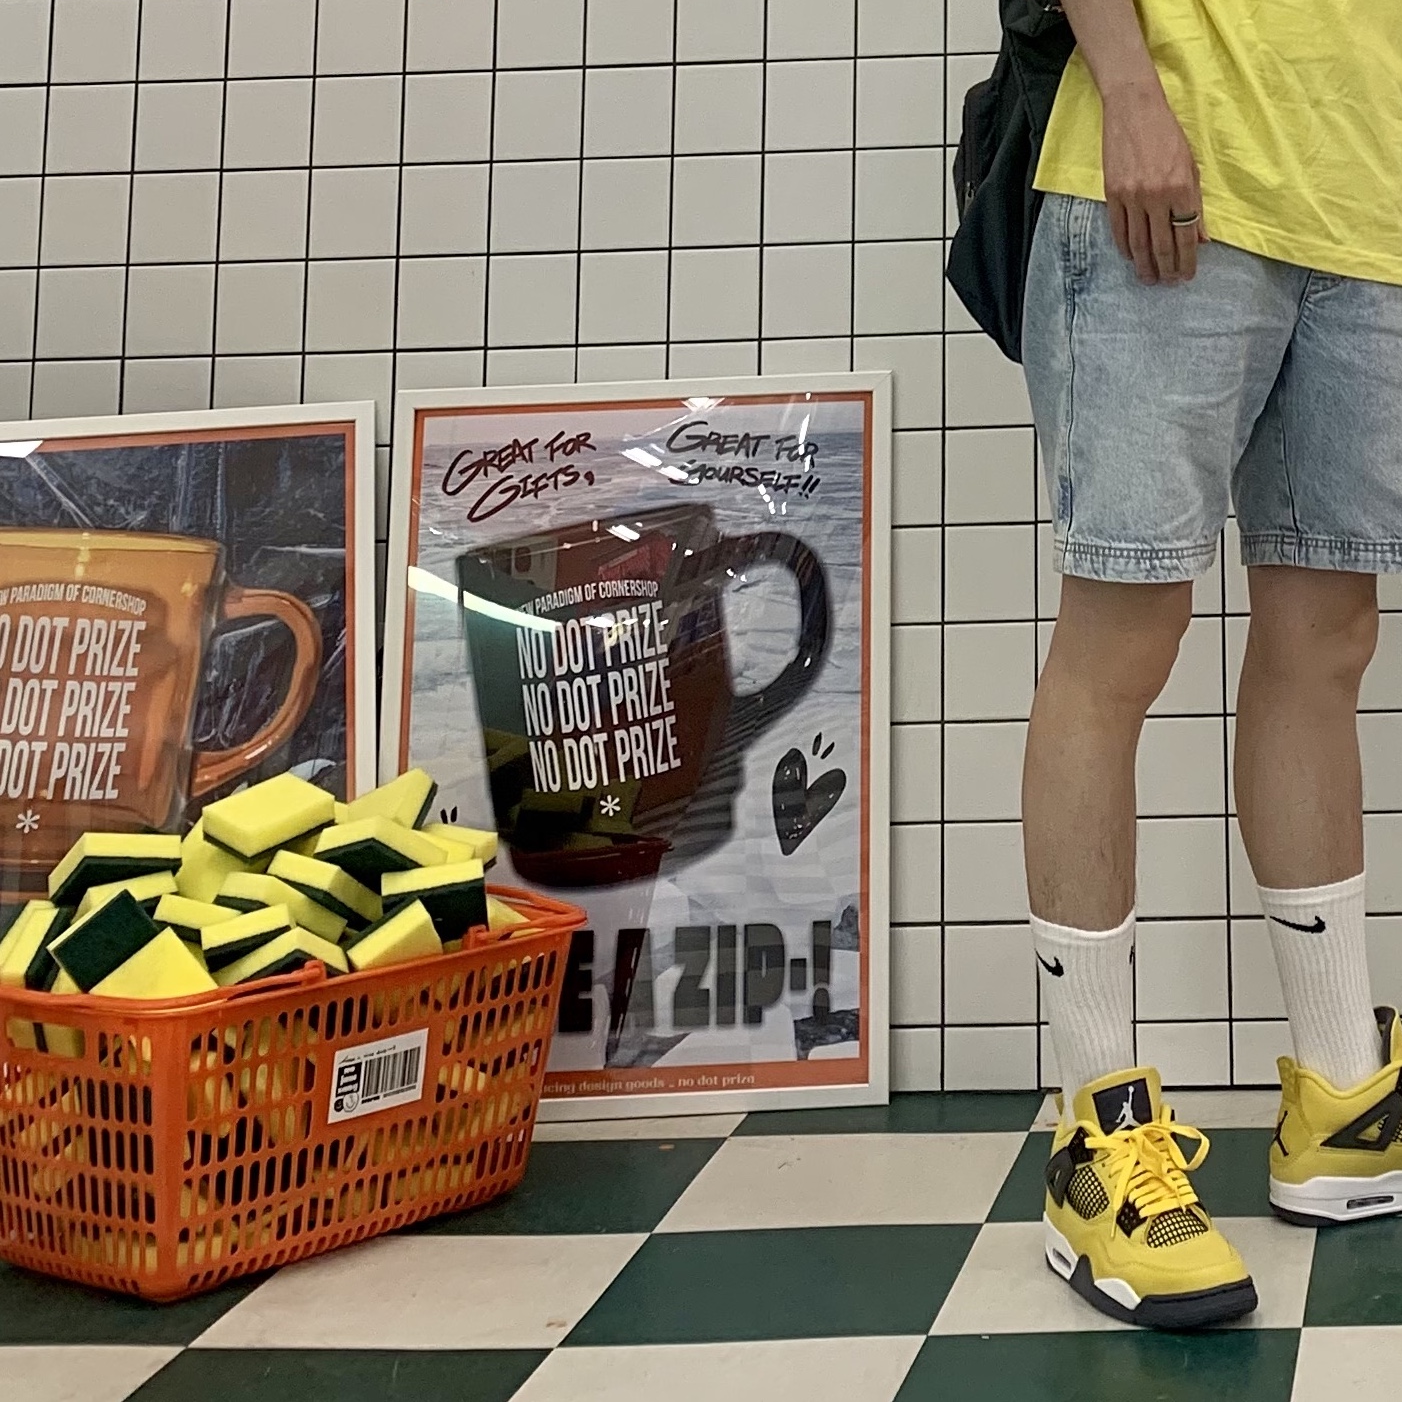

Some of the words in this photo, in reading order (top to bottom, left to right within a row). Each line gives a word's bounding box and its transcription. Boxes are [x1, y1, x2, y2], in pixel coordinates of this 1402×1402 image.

[442, 437, 539, 496] GREAT
[545, 430, 597, 462] FOR
[664, 420, 770, 458] GREAT
[776, 434, 820, 466] FOR
[10, 583, 65, 604] PARADIGM
[65, 584, 81, 602] OF
[81, 585, 147, 616] CORNERSHOP
[535, 584, 583, 615] PARADIGM
[584, 583, 597, 601] OF
[599, 579, 659, 599] CORNERSHOP
[11, 615, 70, 675] DOT
[68, 618, 147, 677] PRIZE
[516, 622, 547, 680] NO
[551, 616, 596, 677] DOT
[601, 600, 669, 668] PRIZE
[0, 678, 59, 736] DOT
[57, 680, 137, 738] PRIZE
[522, 682, 554, 737] NO
[556, 674, 602, 734] DOT
[607, 657, 675, 726] PRIZE
[0, 739, 48, 799] DOT
[46, 742, 126, 800] PRIZE
[529, 740, 561, 793] NO
[563, 732, 609, 791] DOT
[614, 715, 682, 783] PRIZE
[678, 1077, 694, 1088] no
[697, 1074, 718, 1087] dot
